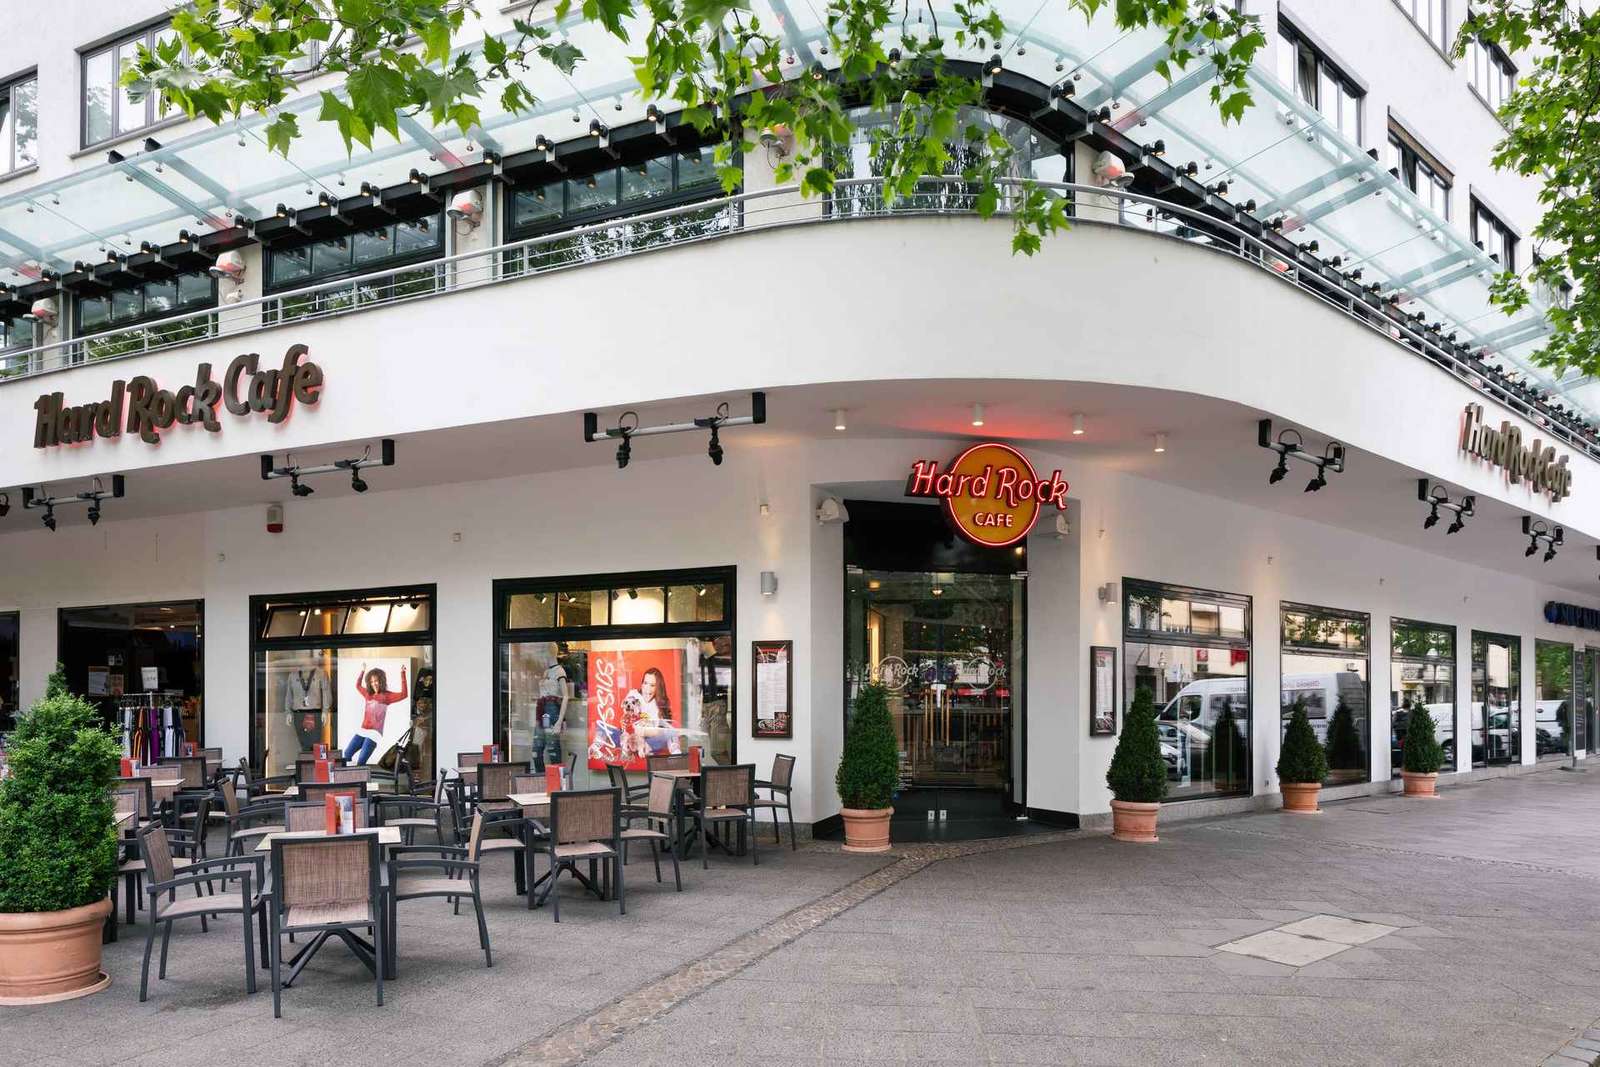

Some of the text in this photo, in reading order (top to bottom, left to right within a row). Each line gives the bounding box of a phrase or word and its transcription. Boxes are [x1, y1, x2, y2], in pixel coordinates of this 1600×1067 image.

[34, 344, 323, 448] Hard Rock Cafe
[911, 460, 1070, 511] Hard Rock
[973, 512, 1014, 528] CAFE
